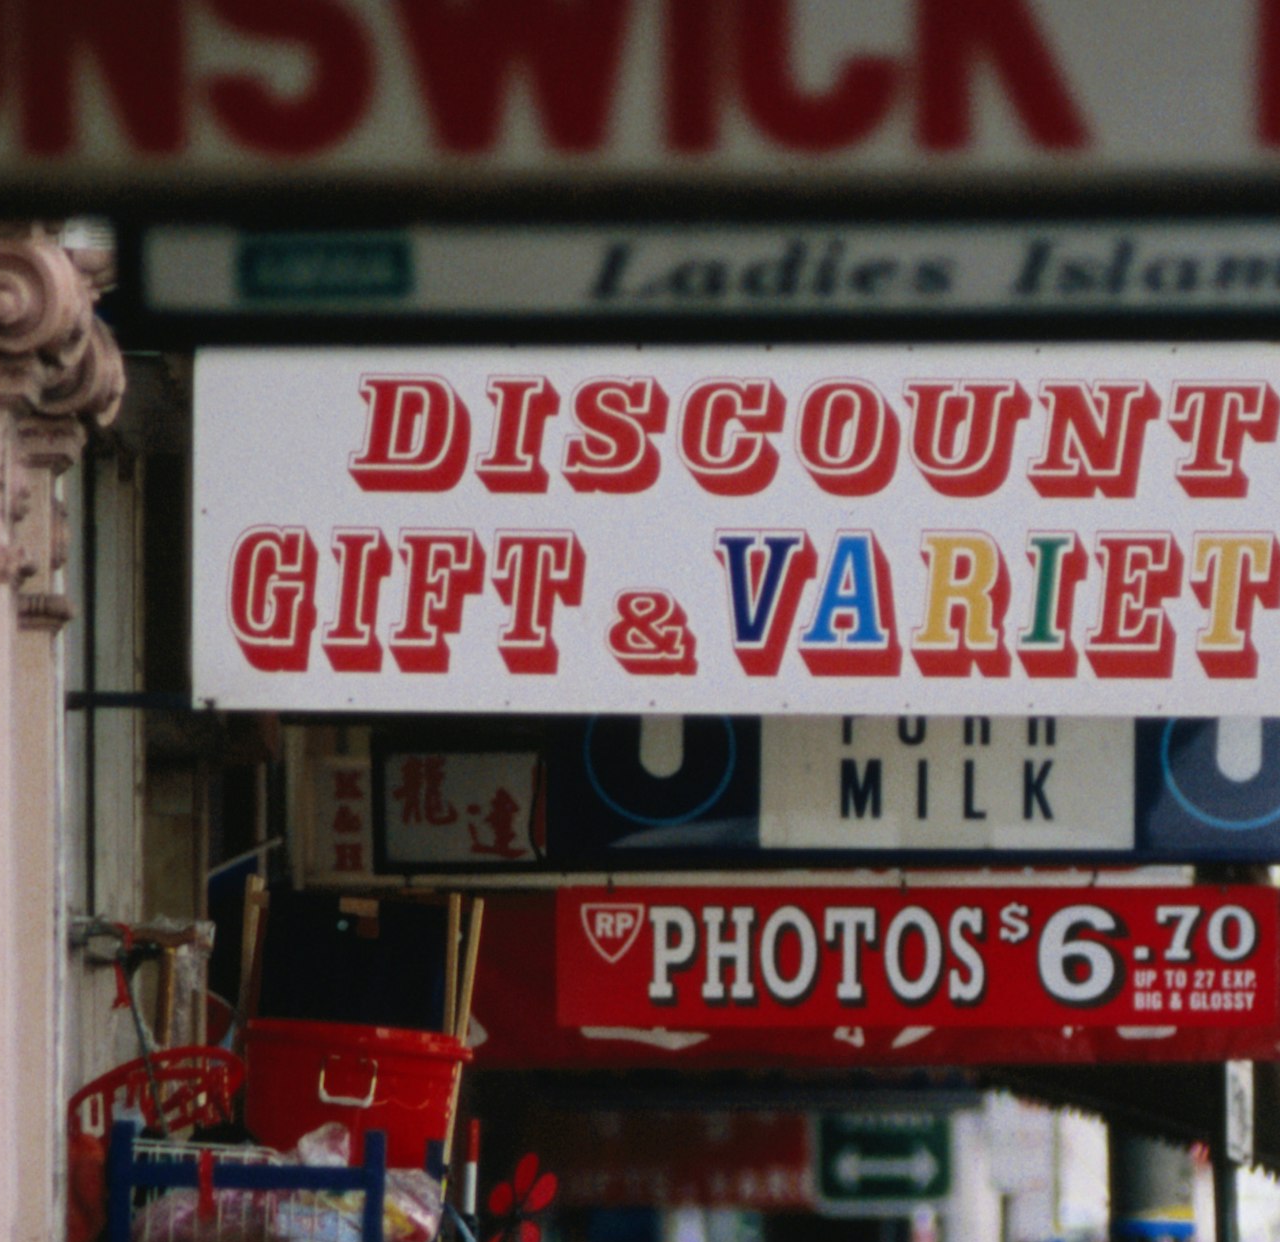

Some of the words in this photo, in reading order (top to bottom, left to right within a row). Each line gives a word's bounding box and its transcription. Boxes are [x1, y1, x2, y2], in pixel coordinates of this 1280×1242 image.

[591, 238, 954, 301] Ladies
[226, 525, 587, 675] GIFT
[604, 587, 698, 677] &
[840, 758, 1054, 820] MILK
[594, 912, 637, 939] RP
[647, 904, 988, 1004] PHOTOS
[1134, 969, 1157, 989] UP
[1164, 969, 1188, 989] TO
[1194, 969, 1216, 989] 27
[1134, 991, 1163, 1012] BIG
[1169, 991, 1183, 1012] &
[1189, 991, 1256, 1012] GLOSSY
